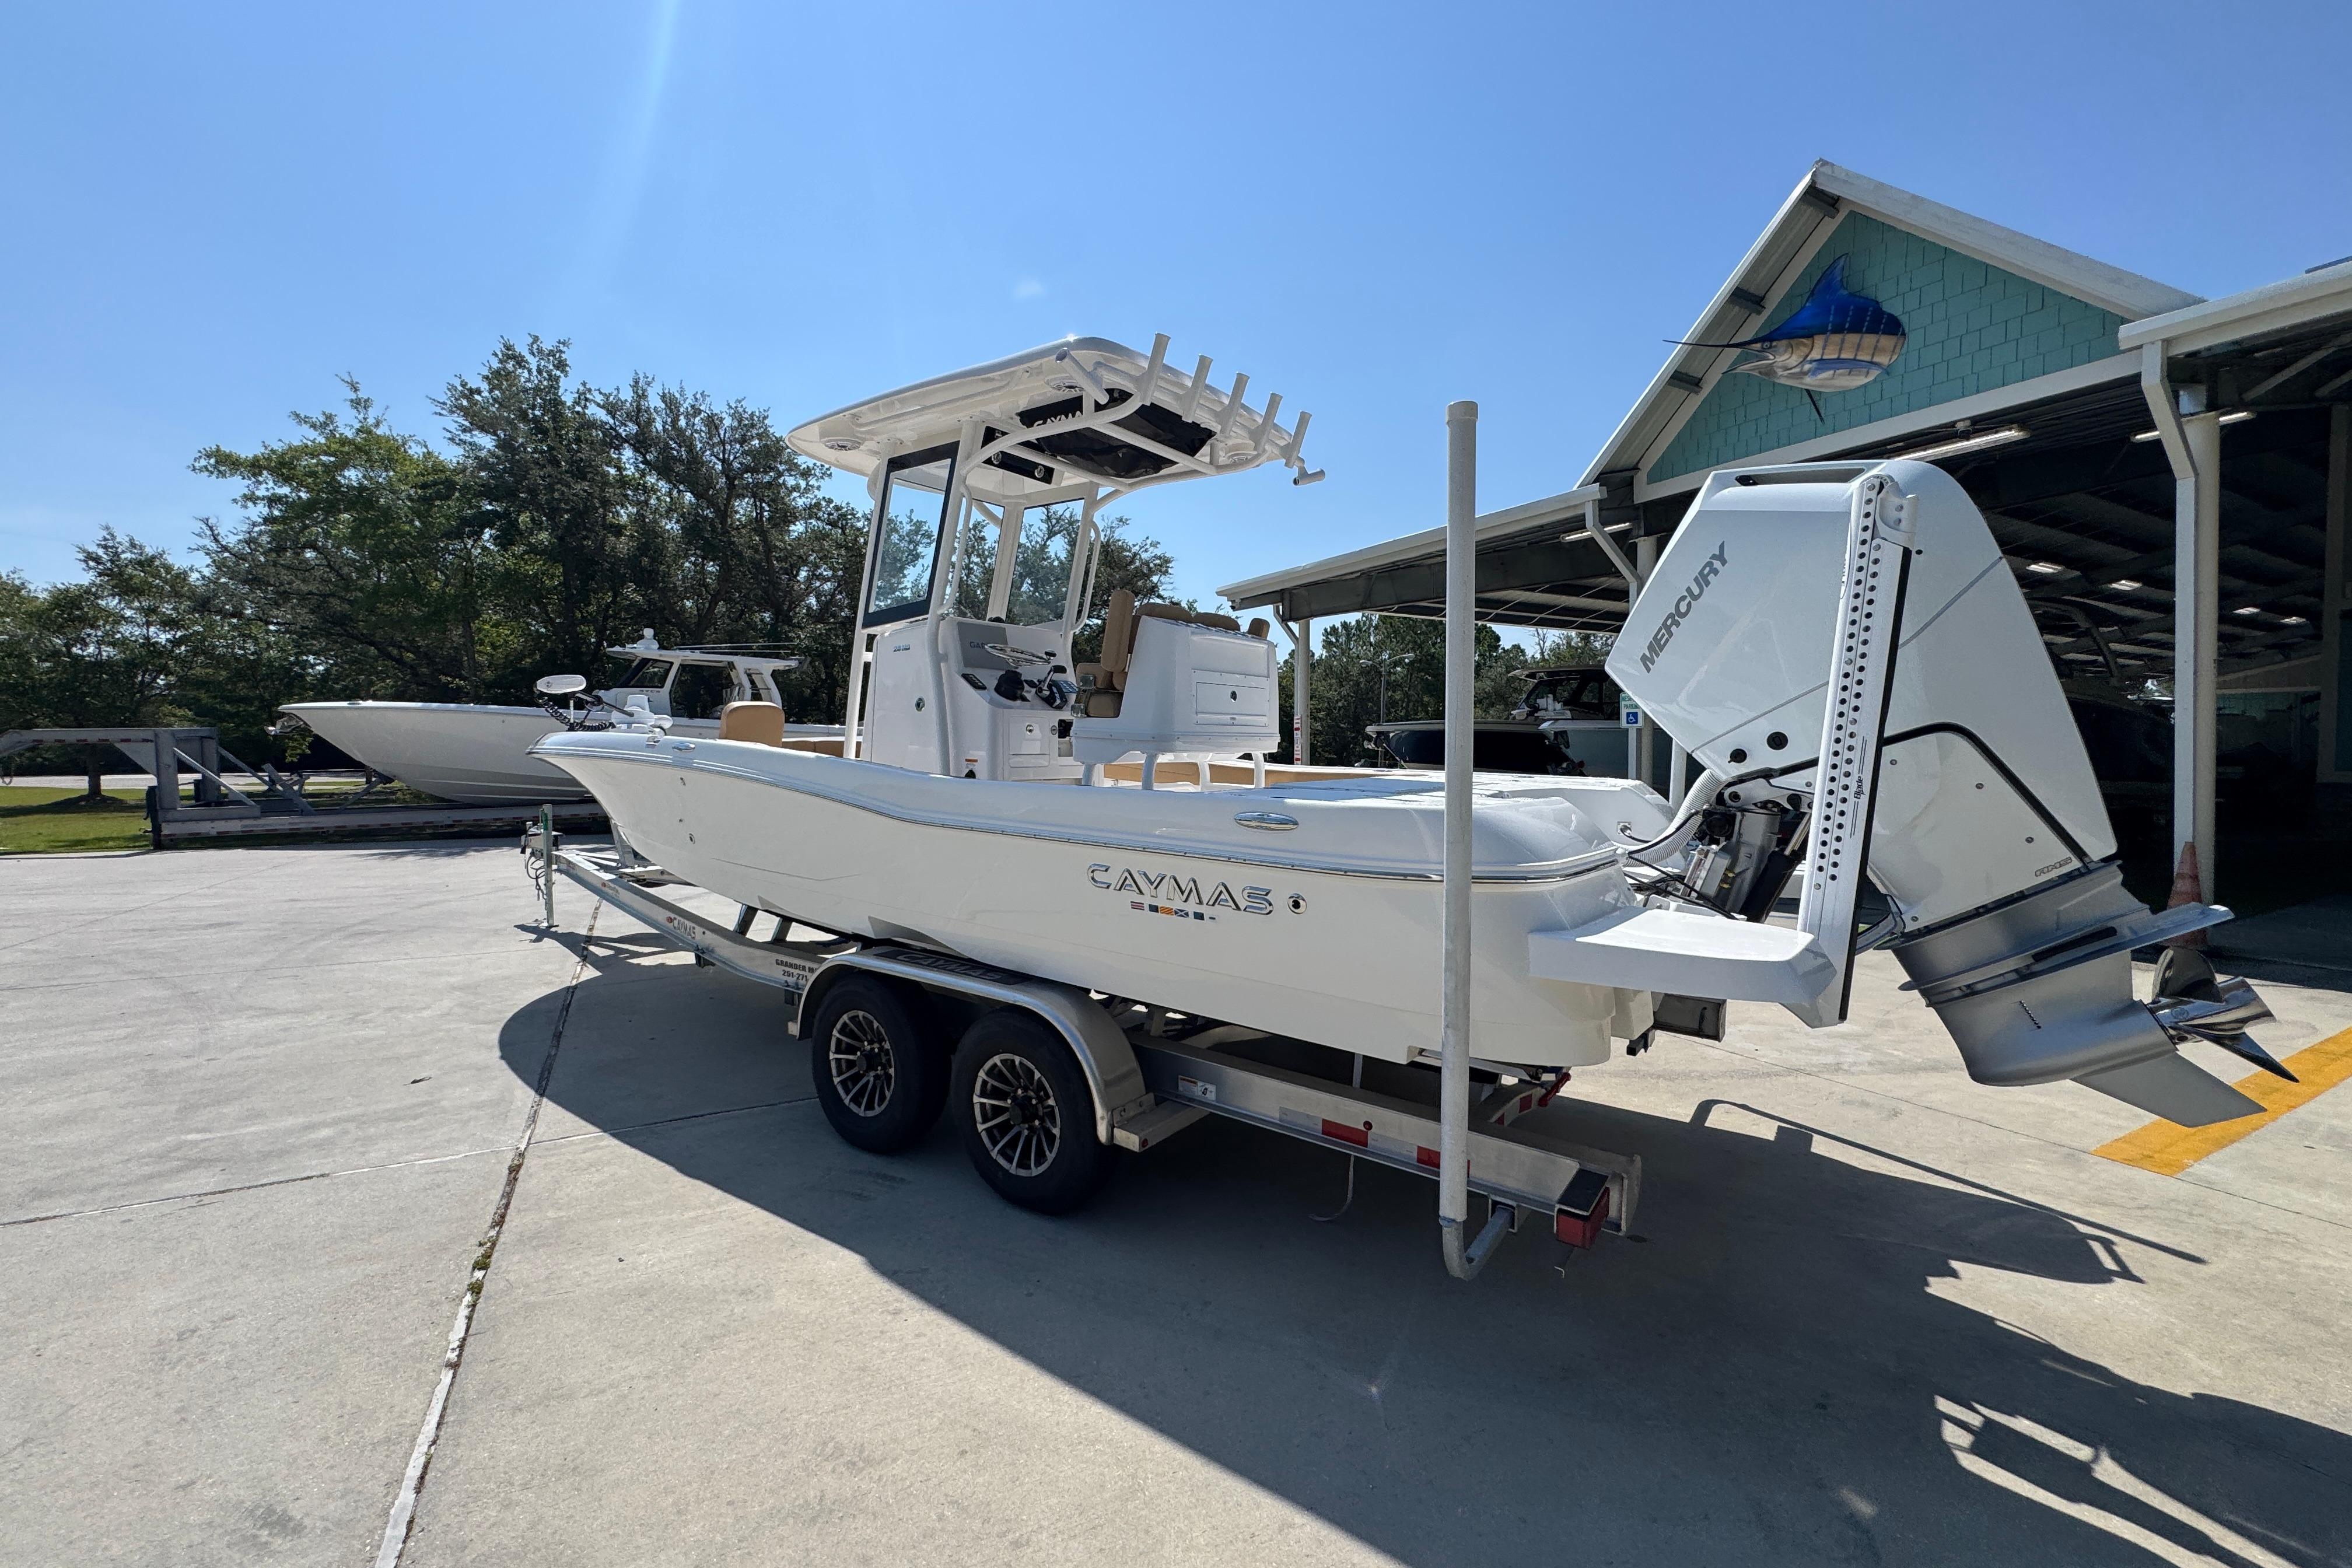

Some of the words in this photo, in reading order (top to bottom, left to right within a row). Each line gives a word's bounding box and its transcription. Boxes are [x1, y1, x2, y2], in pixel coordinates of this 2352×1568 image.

[1640, 541, 1728, 674] MERCURY
[1853, 775, 1866, 800] Blade
[1087, 863, 1274, 915] CAYMAS
[673, 916, 696, 940] CAYMAS
[775, 958, 807, 972] GRANDER
